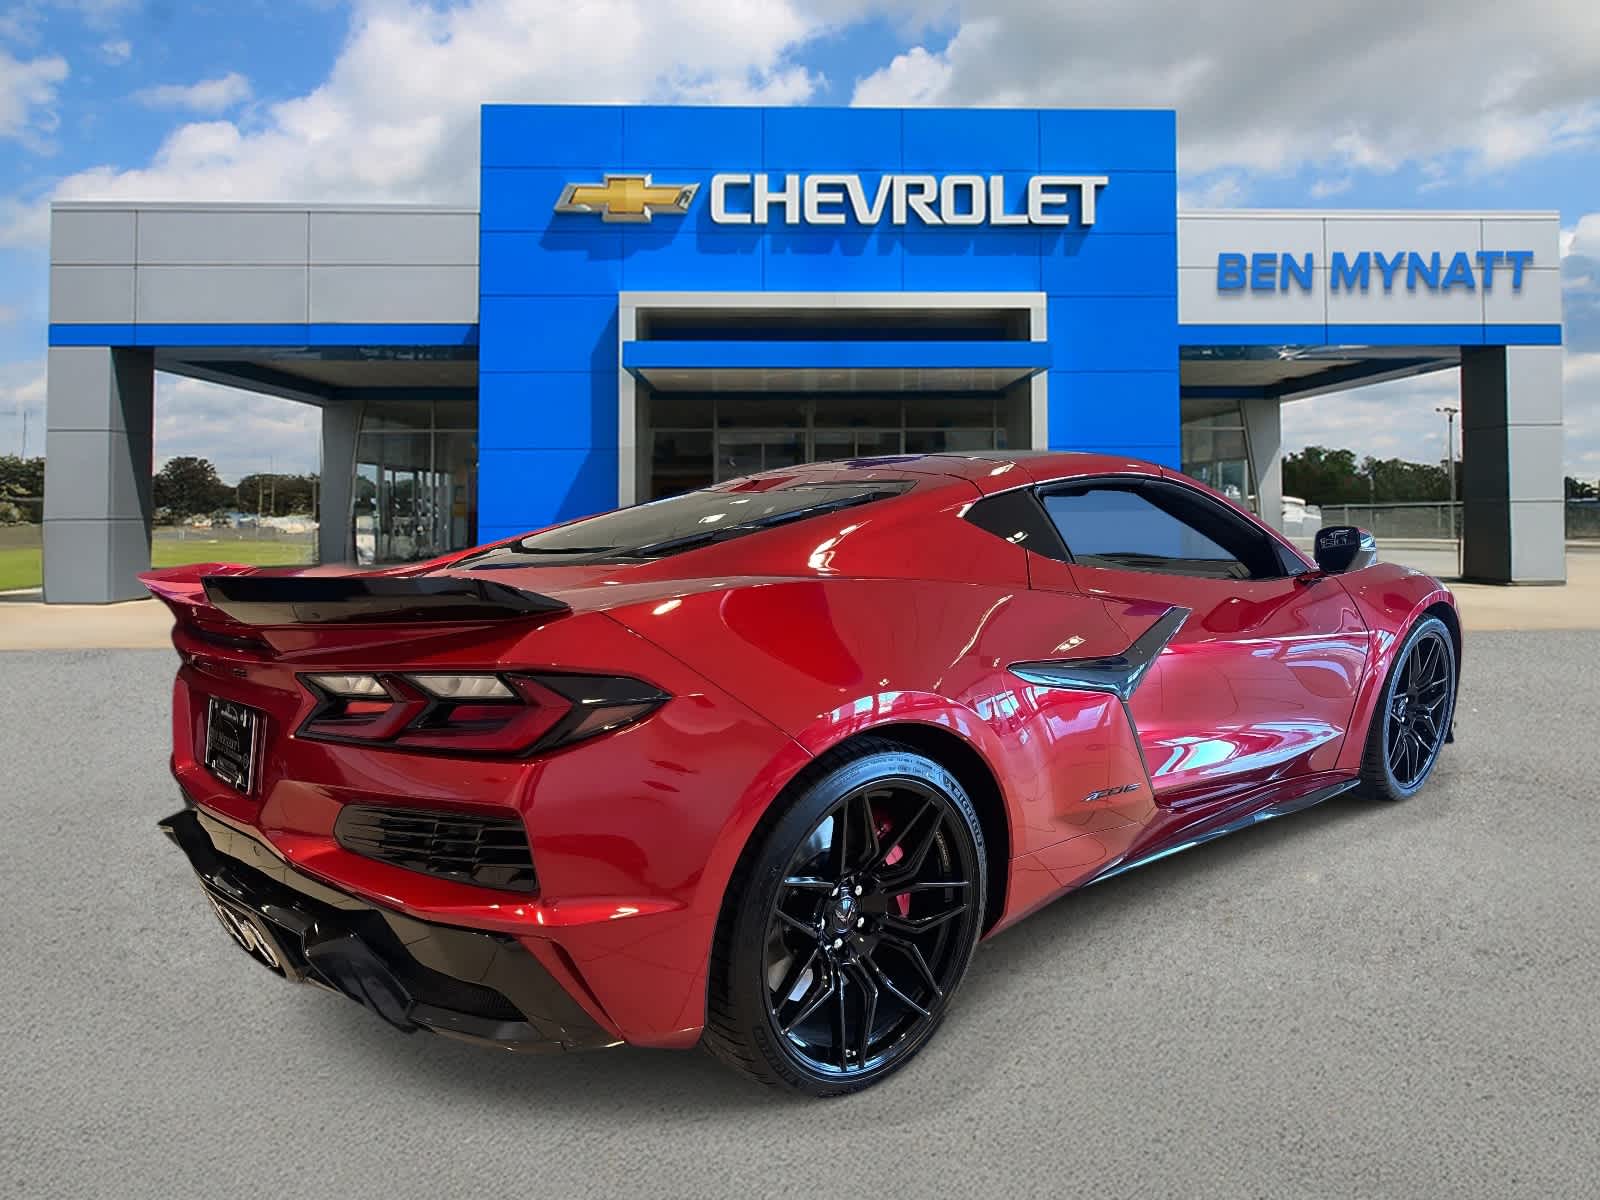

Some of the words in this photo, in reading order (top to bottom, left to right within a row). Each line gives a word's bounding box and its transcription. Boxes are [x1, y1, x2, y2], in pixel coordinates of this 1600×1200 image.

[710, 173, 1109, 225] CHEVROLET
[1217, 252, 1314, 291] BEN
[1330, 250, 1534, 290] MYNATT
